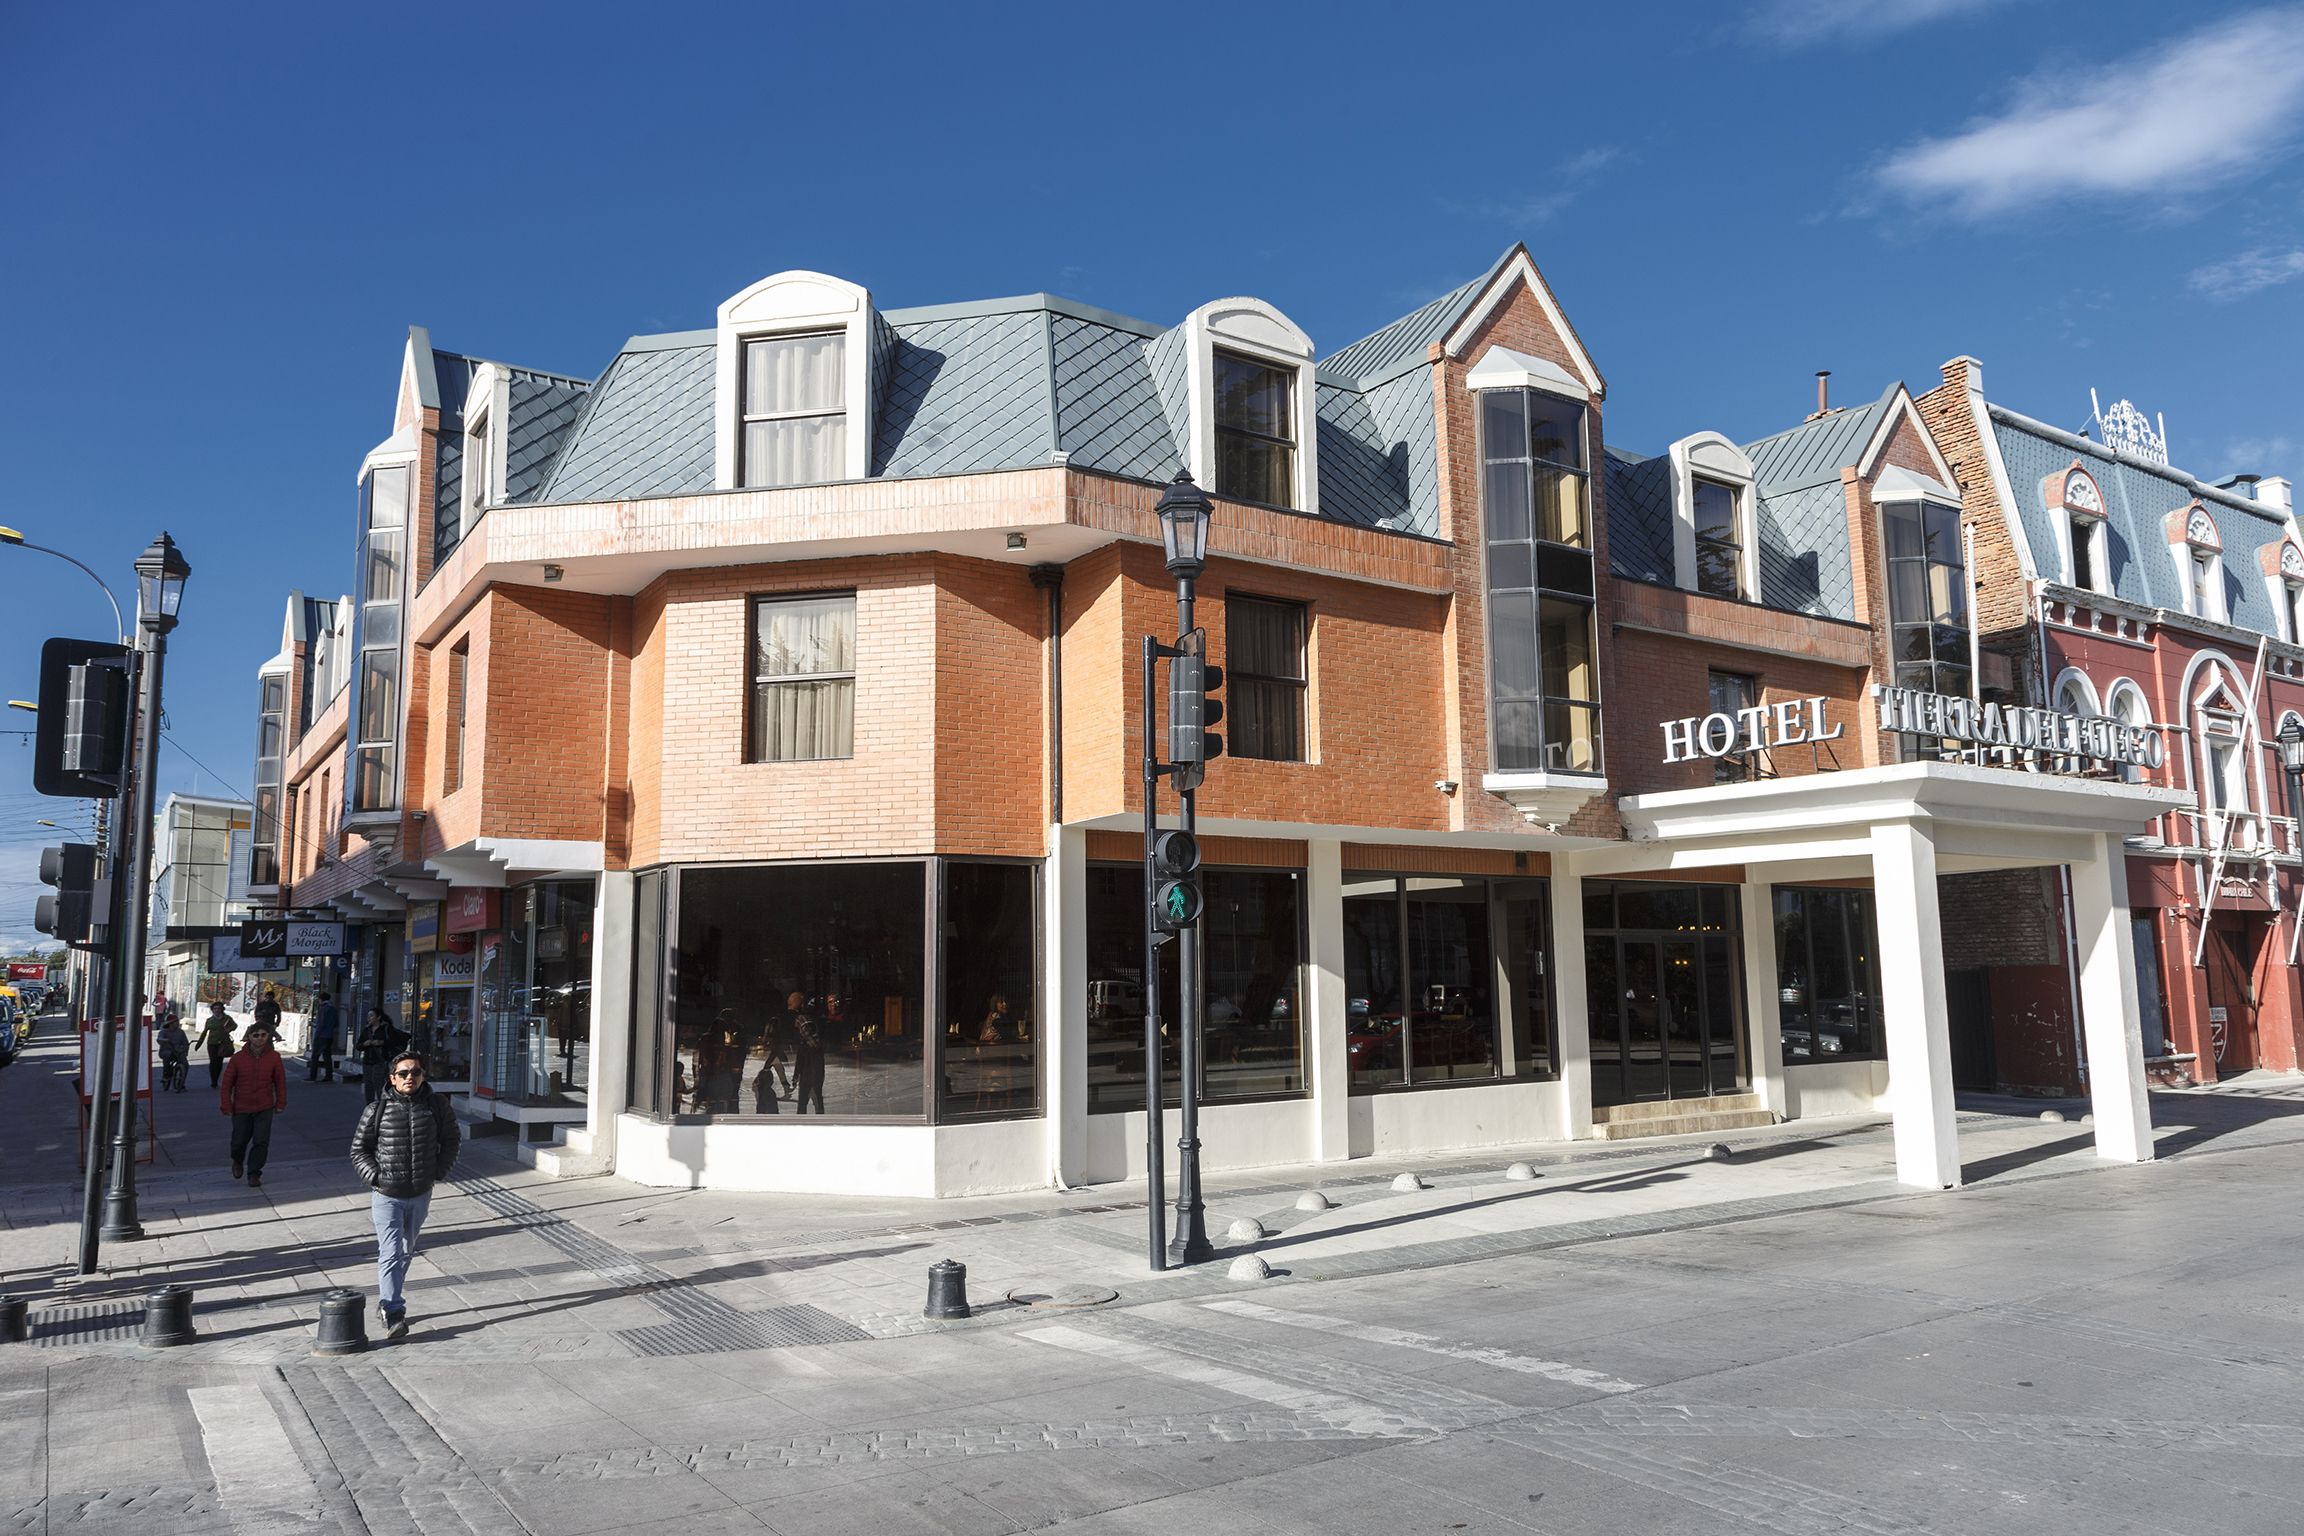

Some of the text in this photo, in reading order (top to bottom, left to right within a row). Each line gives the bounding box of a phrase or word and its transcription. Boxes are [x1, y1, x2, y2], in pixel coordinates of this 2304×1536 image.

[1659, 696, 1846, 764] HOTEL
[1872, 683, 2007, 746] TIERRA
[2002, 704, 2070, 752] DEL
[2063, 714, 2164, 769] FUEGO
[463, 893, 480, 917] Claro
[291, 938, 336, 950] Morgan
[298, 926, 331, 938] Black
